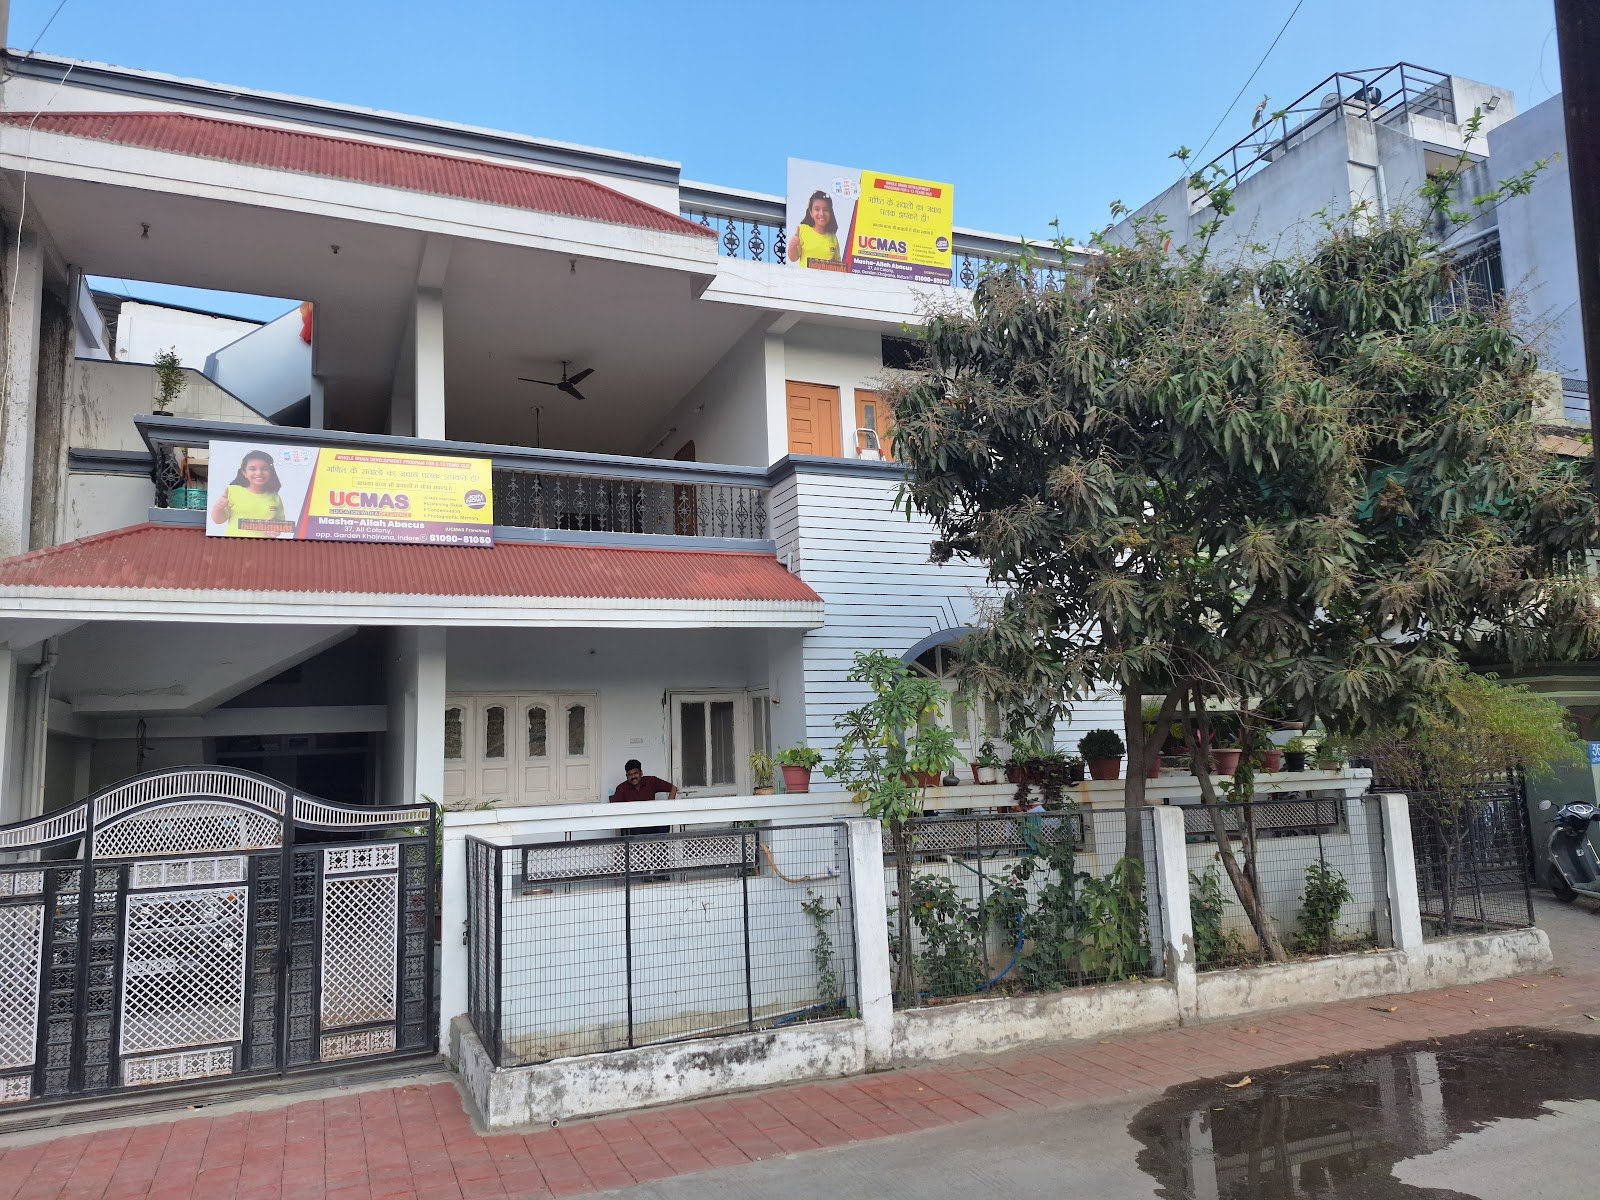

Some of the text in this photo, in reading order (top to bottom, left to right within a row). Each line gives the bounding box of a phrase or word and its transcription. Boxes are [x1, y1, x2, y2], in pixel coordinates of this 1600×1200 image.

[858, 236, 907, 254] UCMAS
[329, 490, 410, 510] UCMAS
[319, 517, 425, 528] Masha-Allah Abacus
[430, 534, 491, 544] 81090-81050
